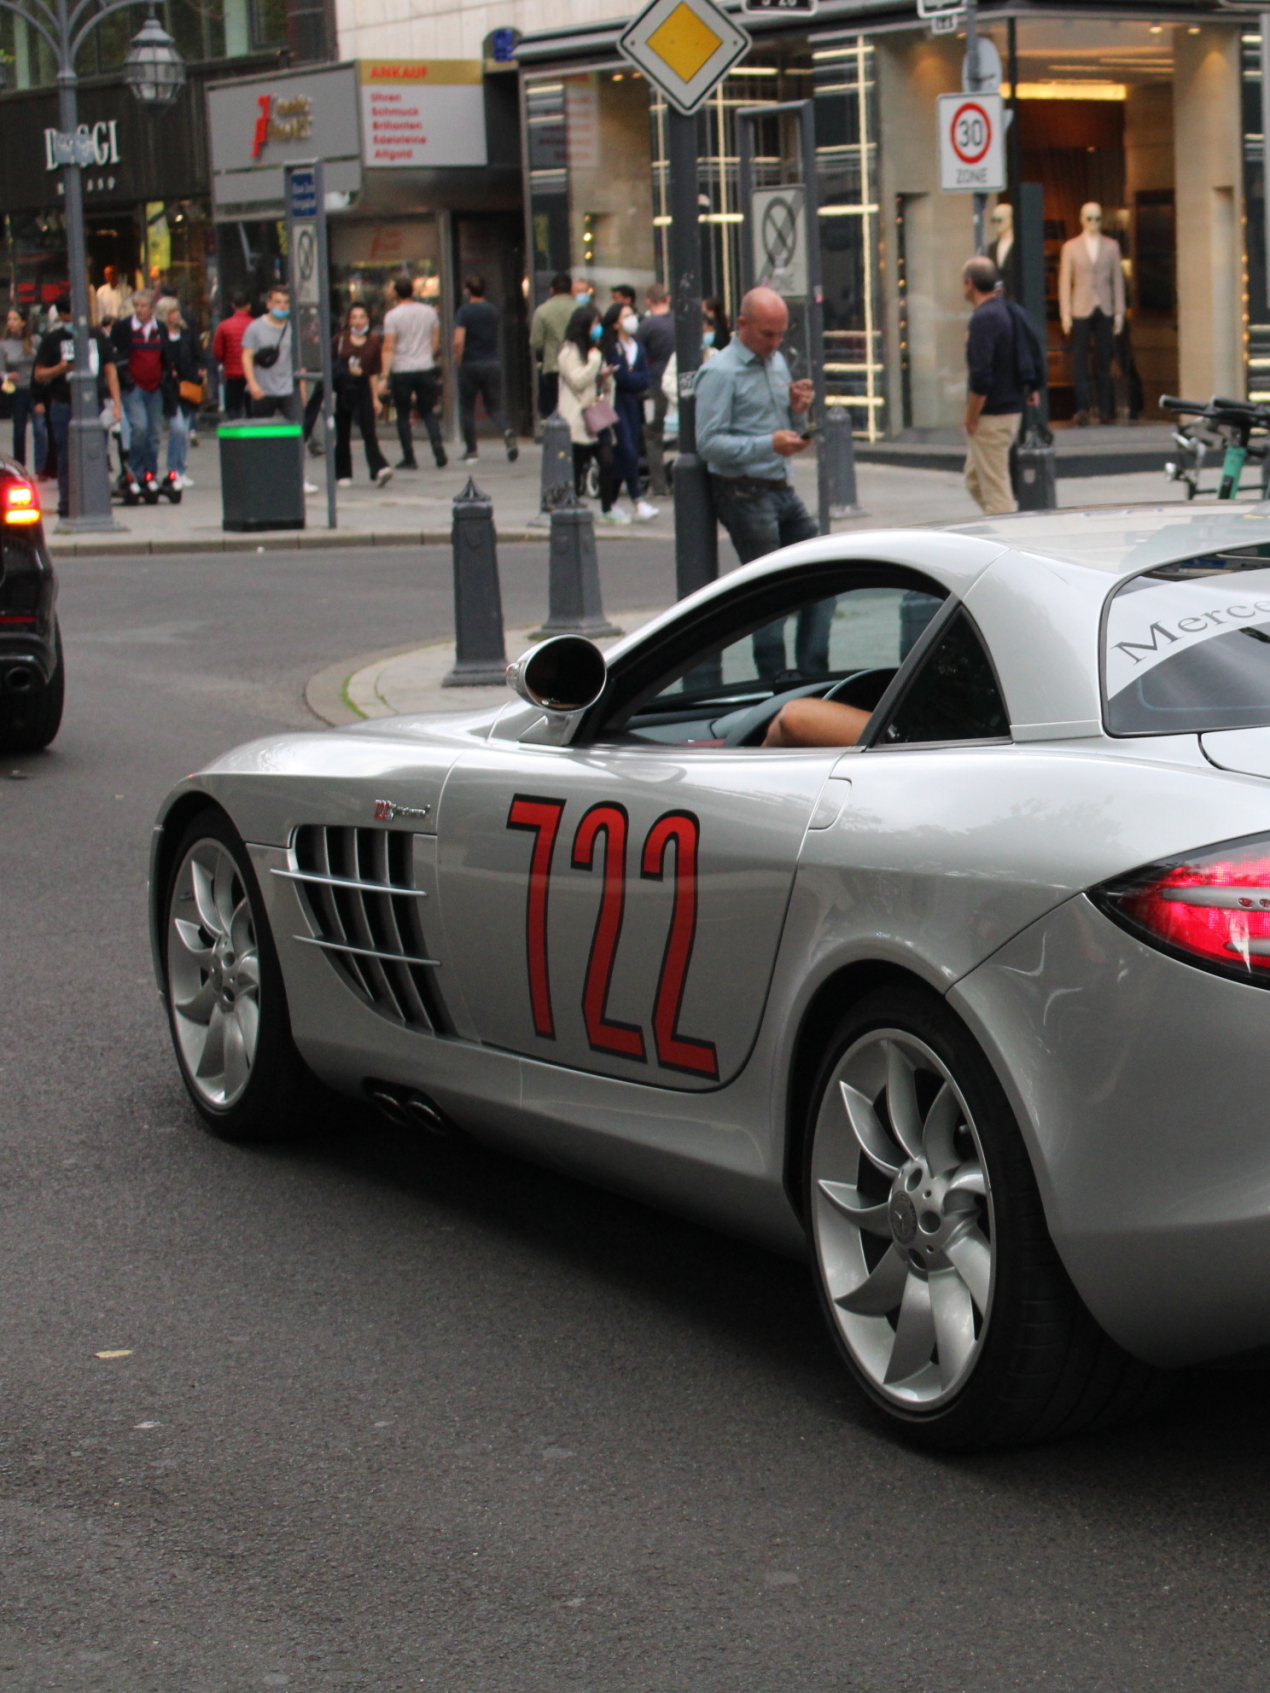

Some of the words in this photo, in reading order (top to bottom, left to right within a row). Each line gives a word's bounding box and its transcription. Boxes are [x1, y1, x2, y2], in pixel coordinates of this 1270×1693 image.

[370, 65, 427, 79] ANKAUF
[370, 92, 402, 103] Uhren
[371, 106, 419, 117] Schmuck
[372, 121, 423, 131] Brillanten
[959, 119, 983, 147] 30
[373, 135, 427, 145] Edelsteine
[375, 149, 414, 161] Altgold
[956, 167, 988, 184] ZONE
[506, 792, 721, 1083] 722
